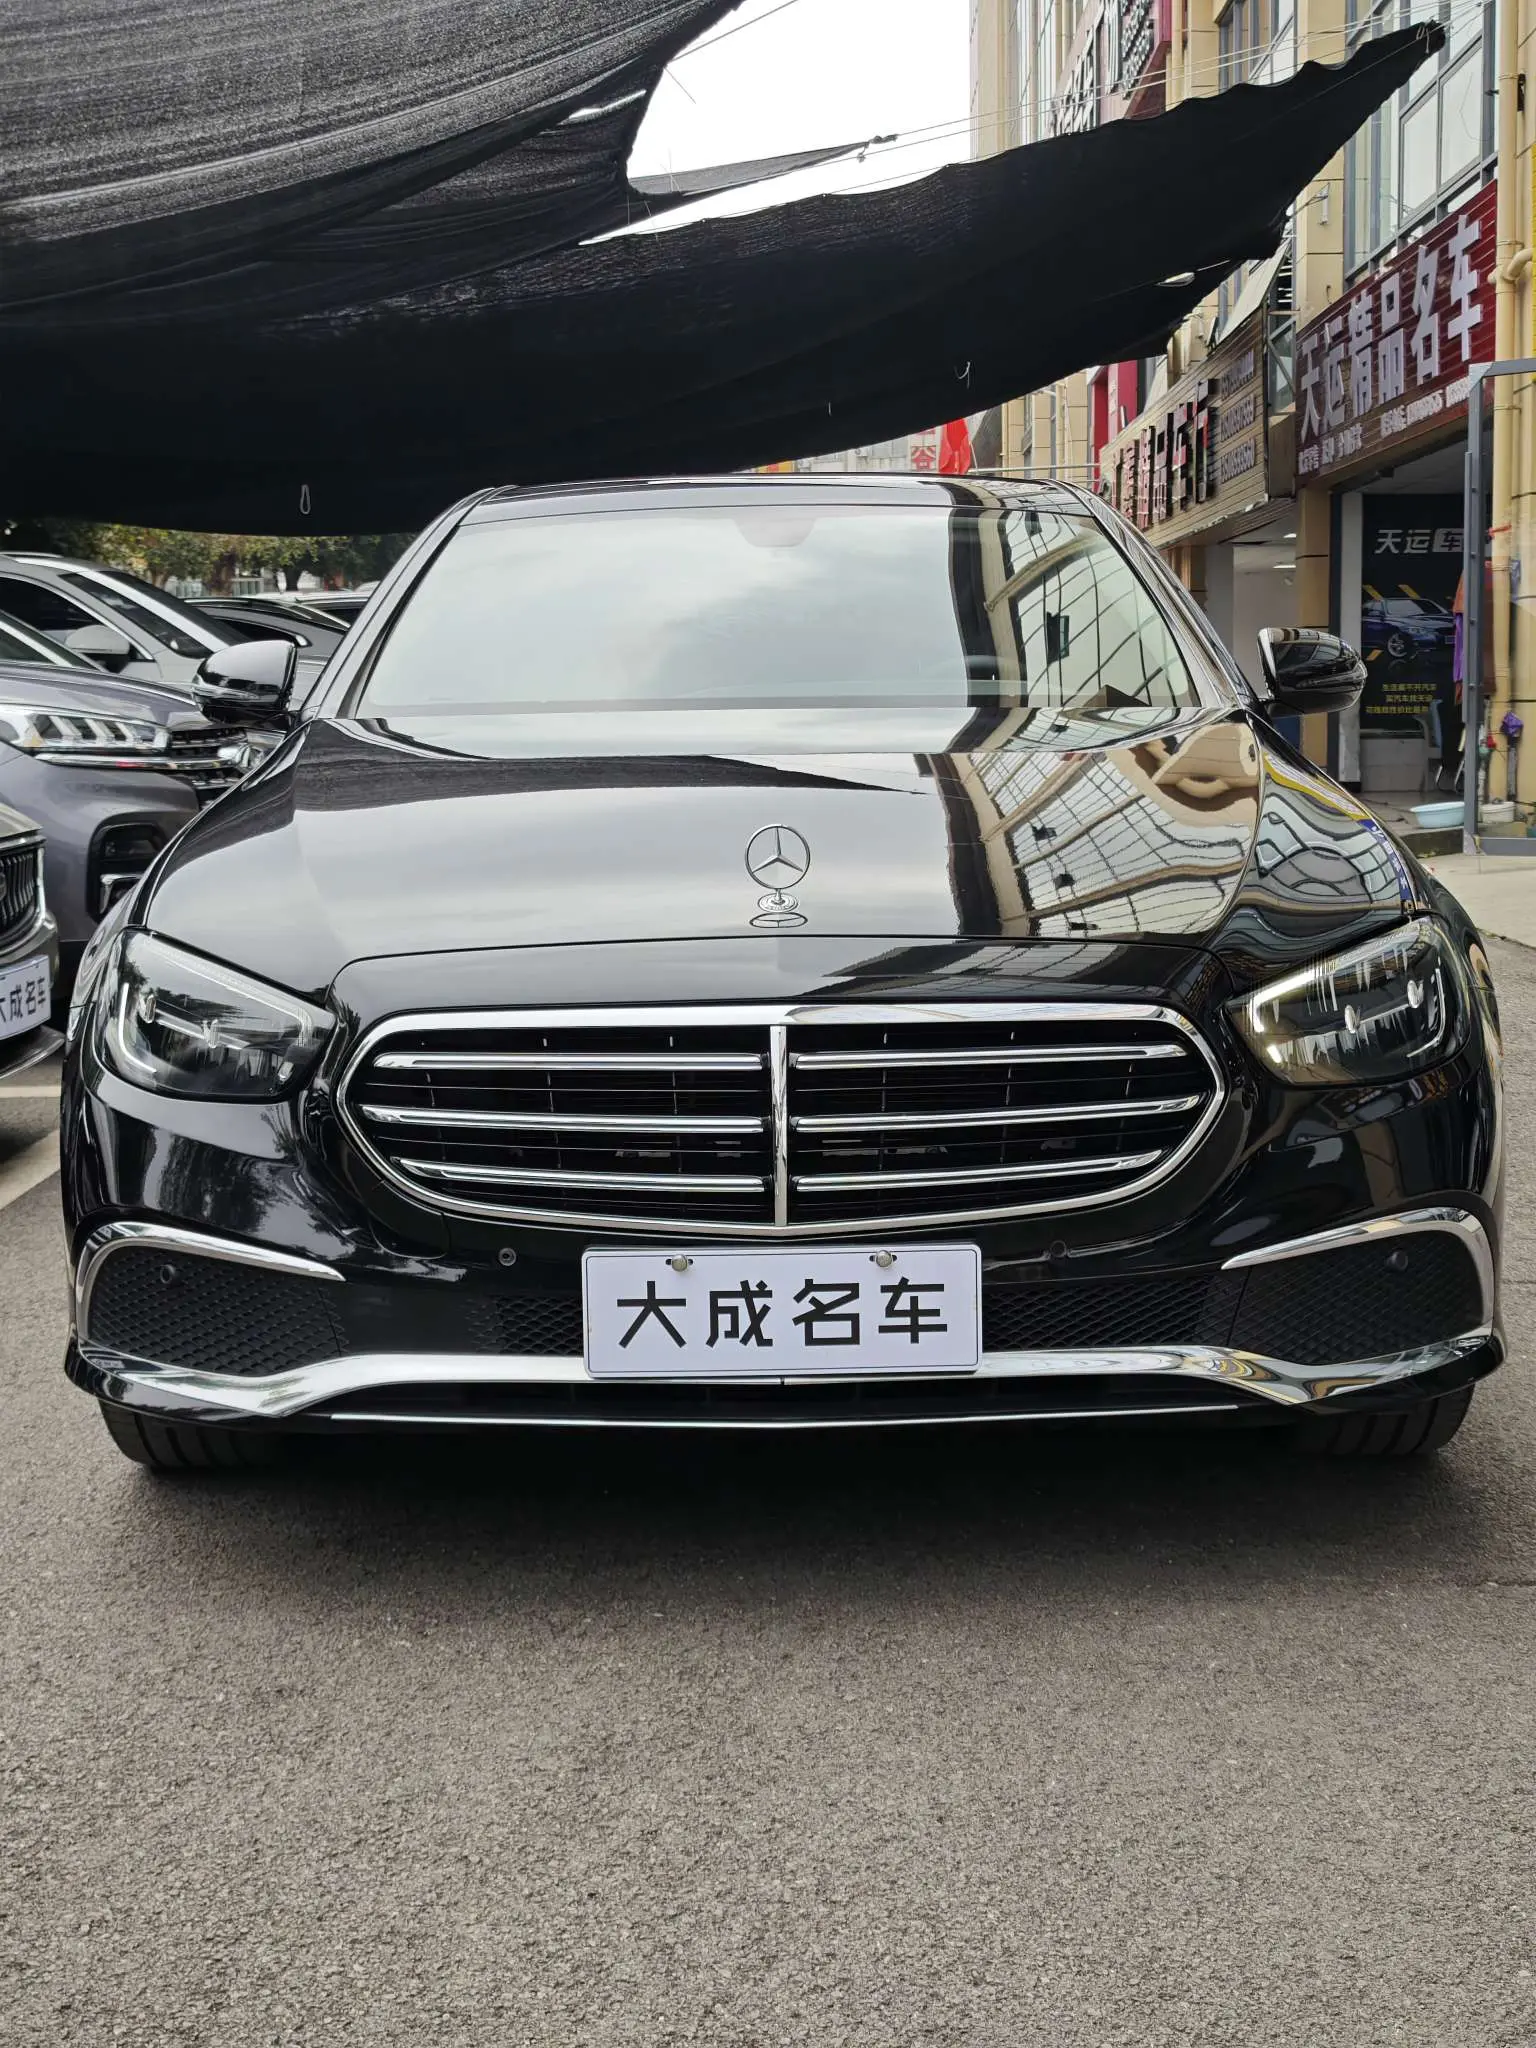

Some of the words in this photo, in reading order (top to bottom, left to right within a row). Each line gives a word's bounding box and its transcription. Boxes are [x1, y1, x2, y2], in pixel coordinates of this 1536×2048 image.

[1300, 214, 1482, 444] 天运精品名车
[616, 1276, 948, 1349] 大成名车
